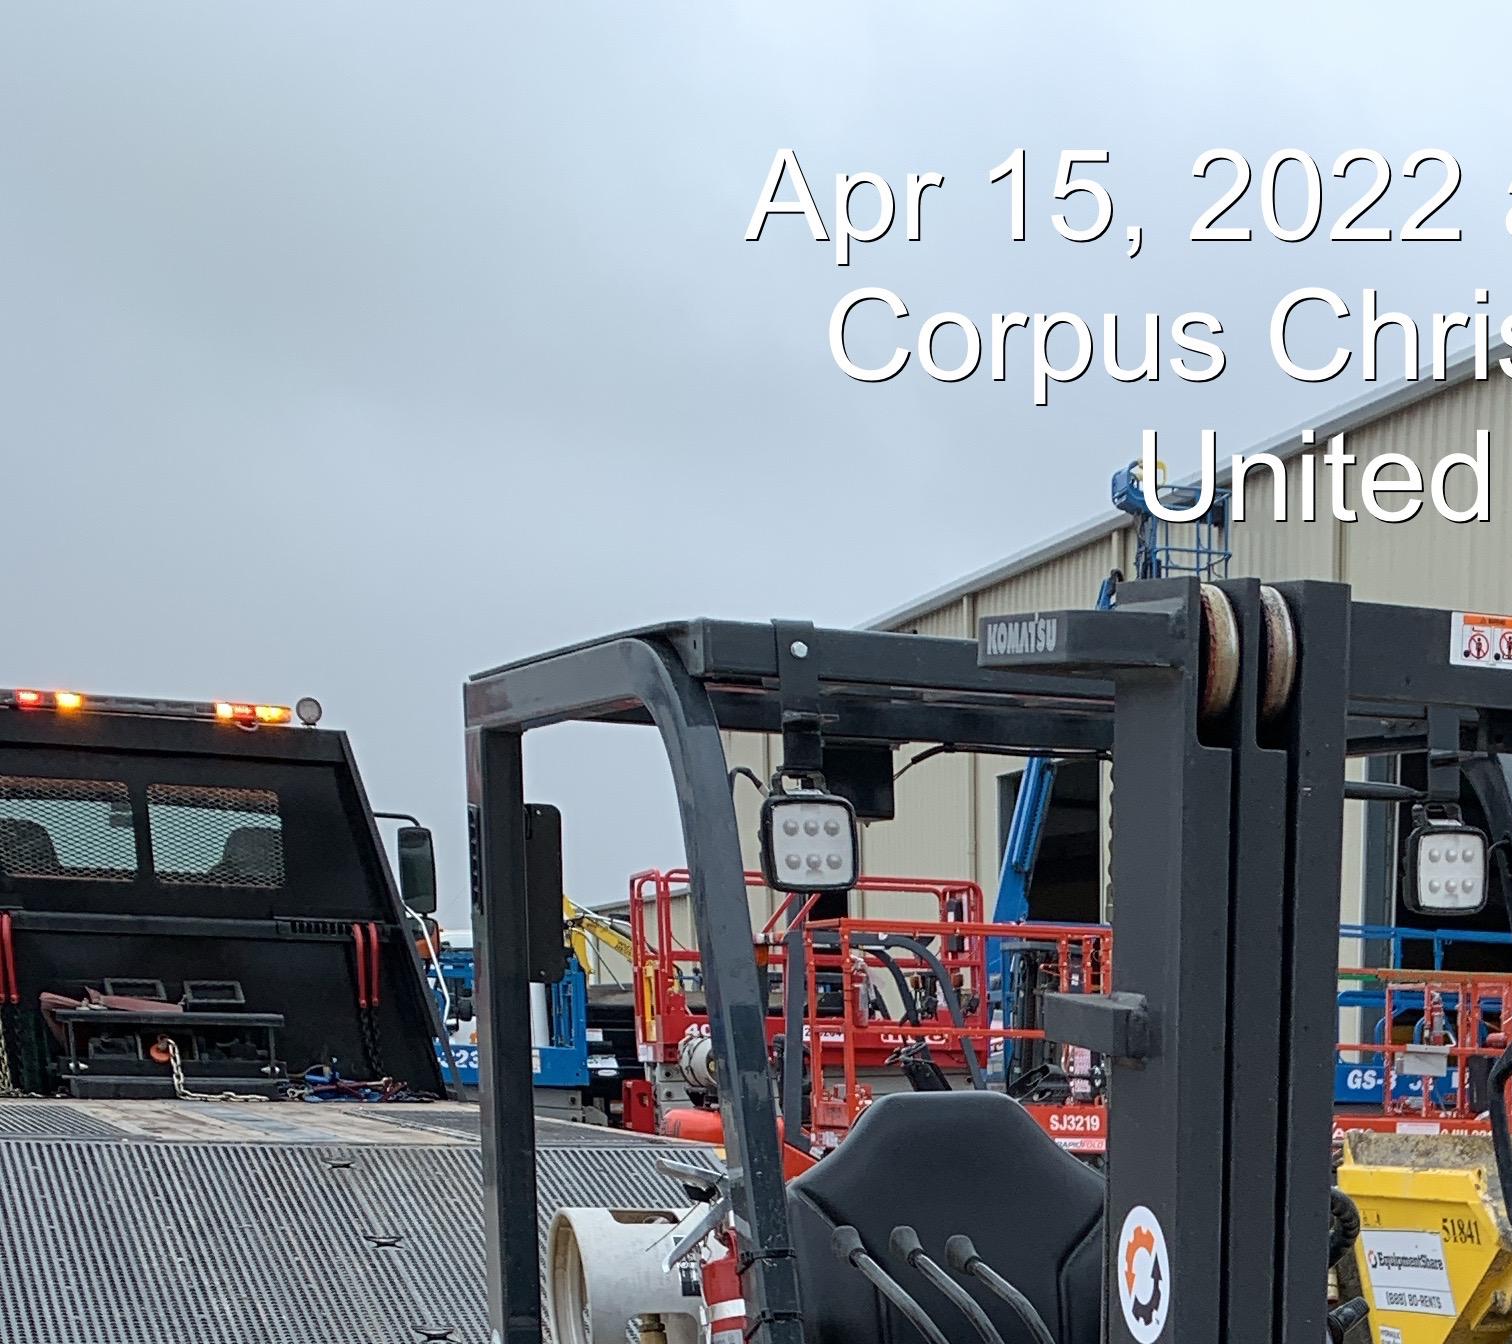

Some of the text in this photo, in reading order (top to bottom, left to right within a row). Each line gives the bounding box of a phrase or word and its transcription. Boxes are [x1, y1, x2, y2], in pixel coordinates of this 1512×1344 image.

[986, 612, 1057, 655] KOMATSU
[1049, 1115, 1100, 1132] SJ3219
[1442, 1218, 1481, 1246] 51841
[1377, 1252, 1444, 1271] EquipmentShare
